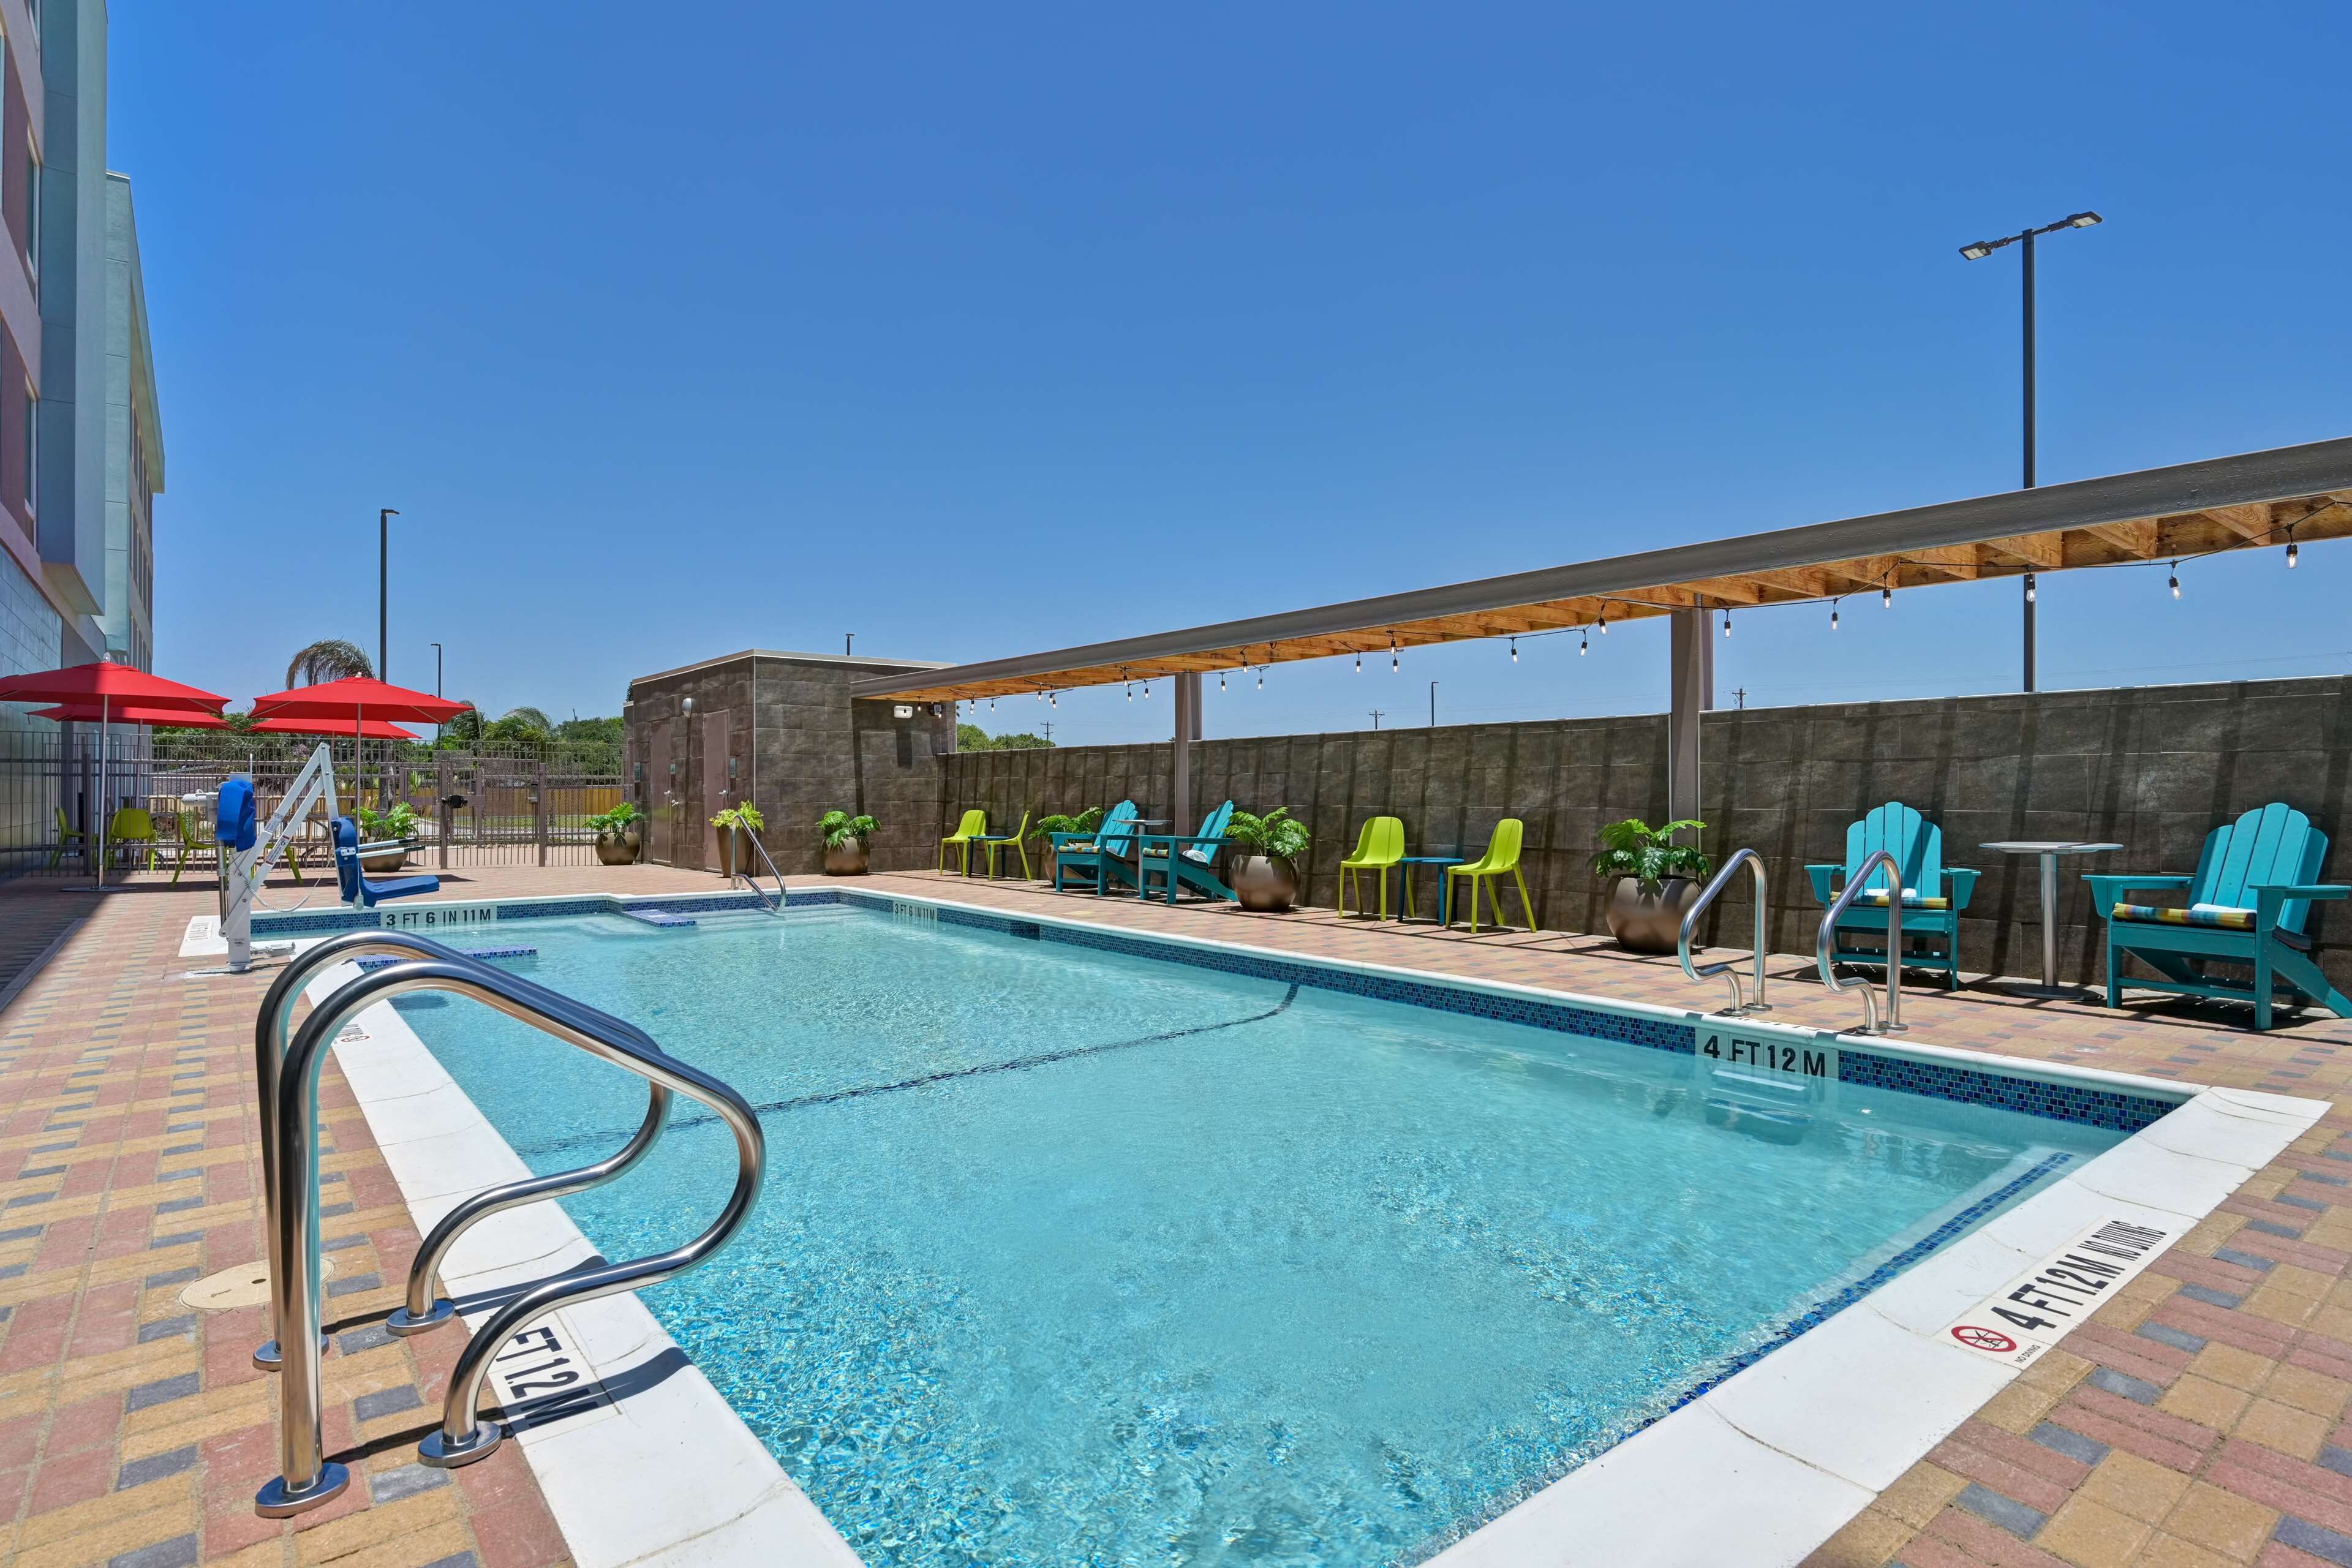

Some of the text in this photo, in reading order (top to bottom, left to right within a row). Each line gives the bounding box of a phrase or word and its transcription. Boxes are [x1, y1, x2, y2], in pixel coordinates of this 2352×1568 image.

[386, 914, 396, 925] 3
[403, 913, 419, 924] FT
[426, 911, 435, 923] 6
[443, 910, 457, 922] IN
[895, 903, 899, 914] 3
[900, 904, 907, 915] FT
[909, 905, 913, 916] 6
[1703, 1035, 1720, 1058] 4
[1732, 1039, 1760, 1066] FT
[1803, 1050, 1825, 1077] M
[2091, 1221, 2167, 1251] DIVING
[2077, 1240, 2142, 1261] NO
[2056, 1254, 2126, 1279] M
[2007, 1283, 2084, 1317] FT
[1991, 1306, 2057, 1330] 4
[2022, 1344, 2041, 1357] DIVING
[521, 1388, 599, 1428] M
